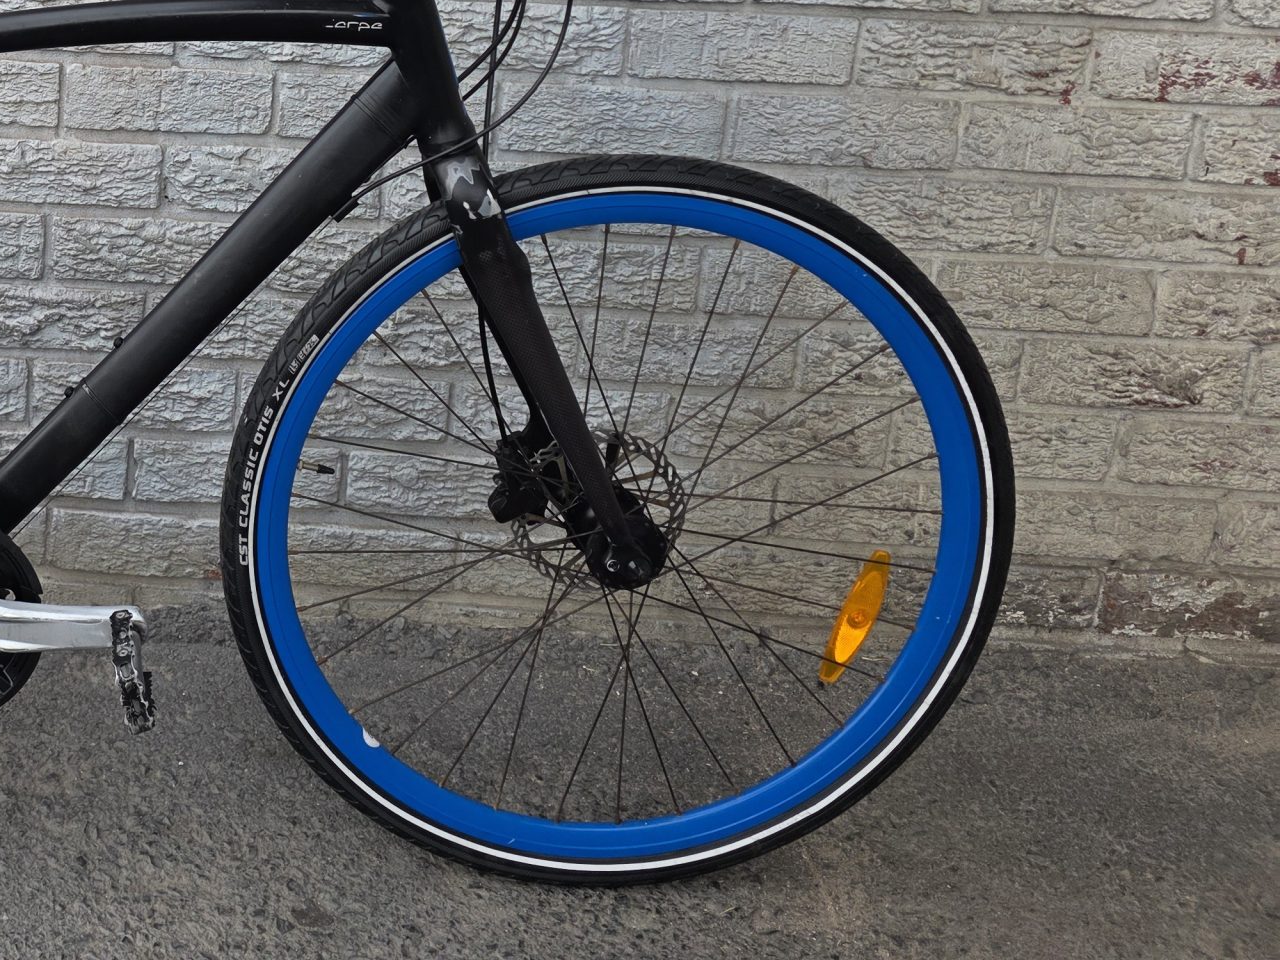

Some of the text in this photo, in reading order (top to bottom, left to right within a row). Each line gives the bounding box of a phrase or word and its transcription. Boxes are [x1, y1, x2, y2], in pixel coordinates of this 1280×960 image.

[272, 378, 290, 401] XL
[253, 405, 274, 446] OTIS
[239, 447, 259, 528] CLASSIC
[238, 533, 249, 566] CST
